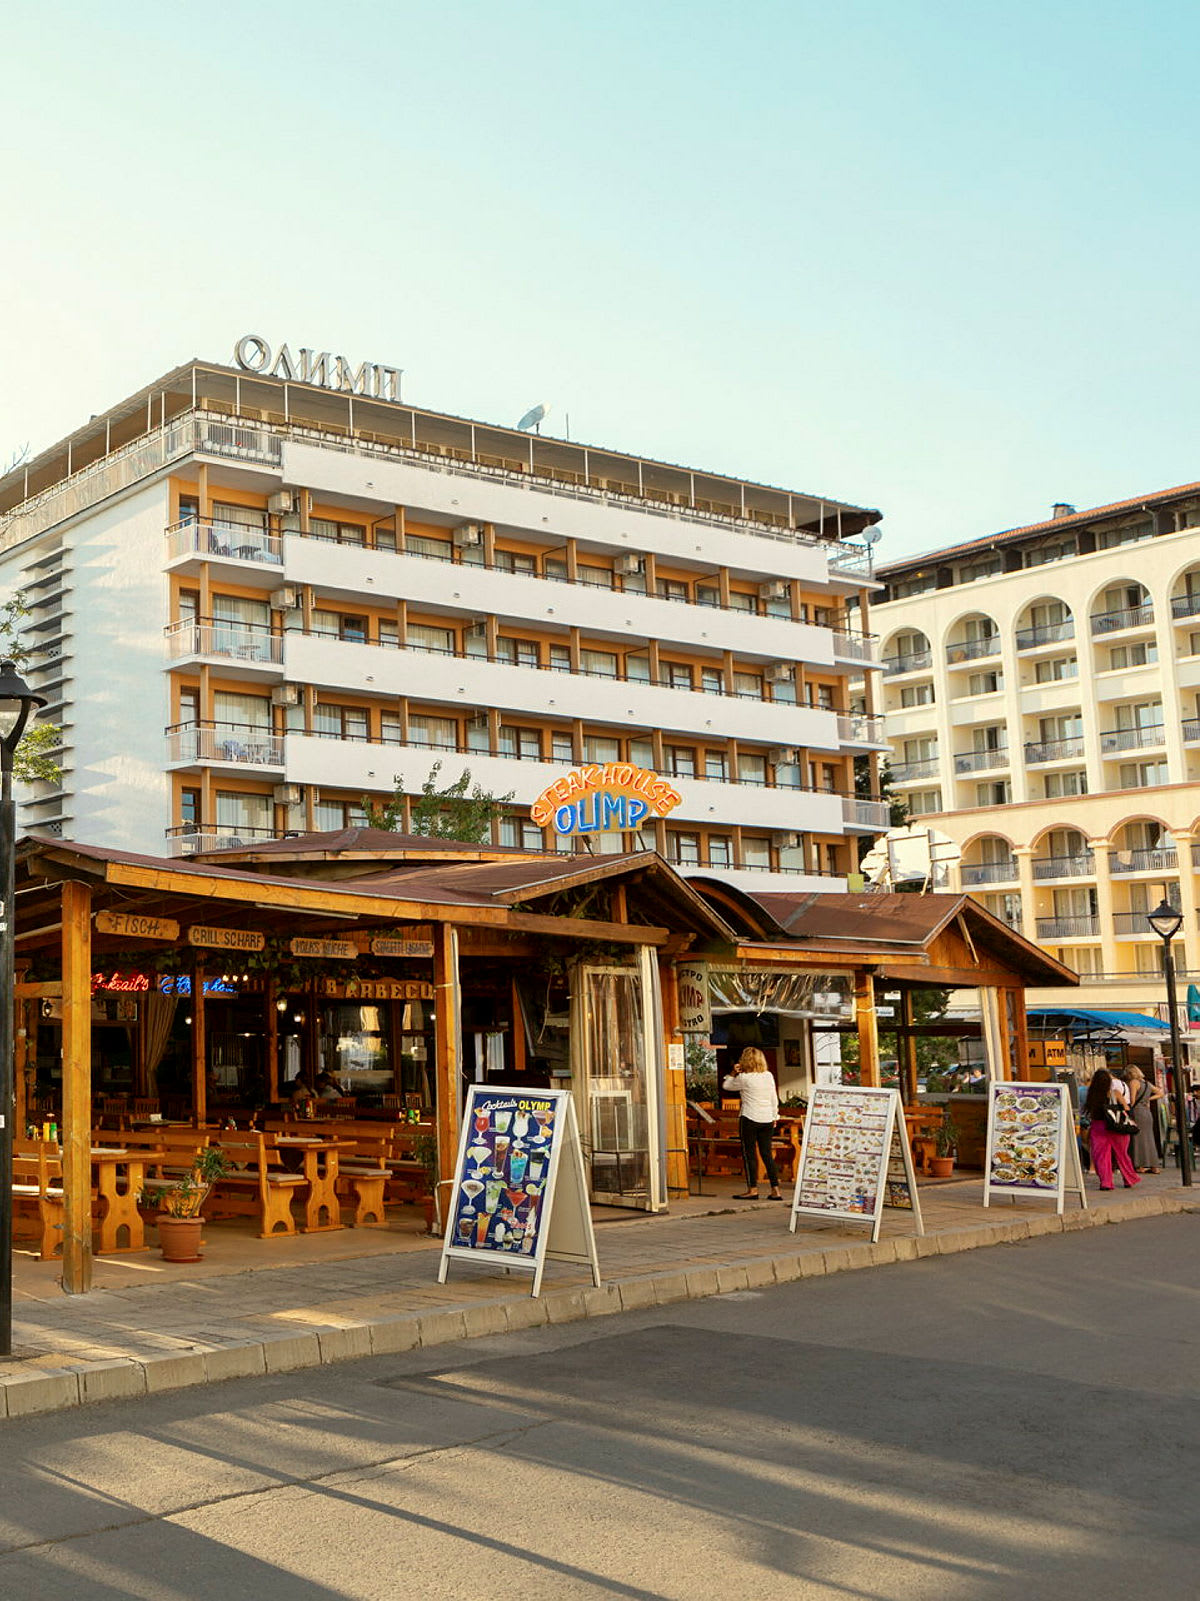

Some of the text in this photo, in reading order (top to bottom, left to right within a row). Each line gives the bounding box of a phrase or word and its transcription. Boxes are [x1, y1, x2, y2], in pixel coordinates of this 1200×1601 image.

[234, 334, 404, 403] ОЛИМП
[531, 763, 680, 824] STEAK HOUSE
[555, 792, 649, 835] OLIMP
[192, 928, 262, 948] GRILL SCHARF
[1046, 1047, 1065, 1058] ATM
[518, 1100, 551, 1111] OLYMP
